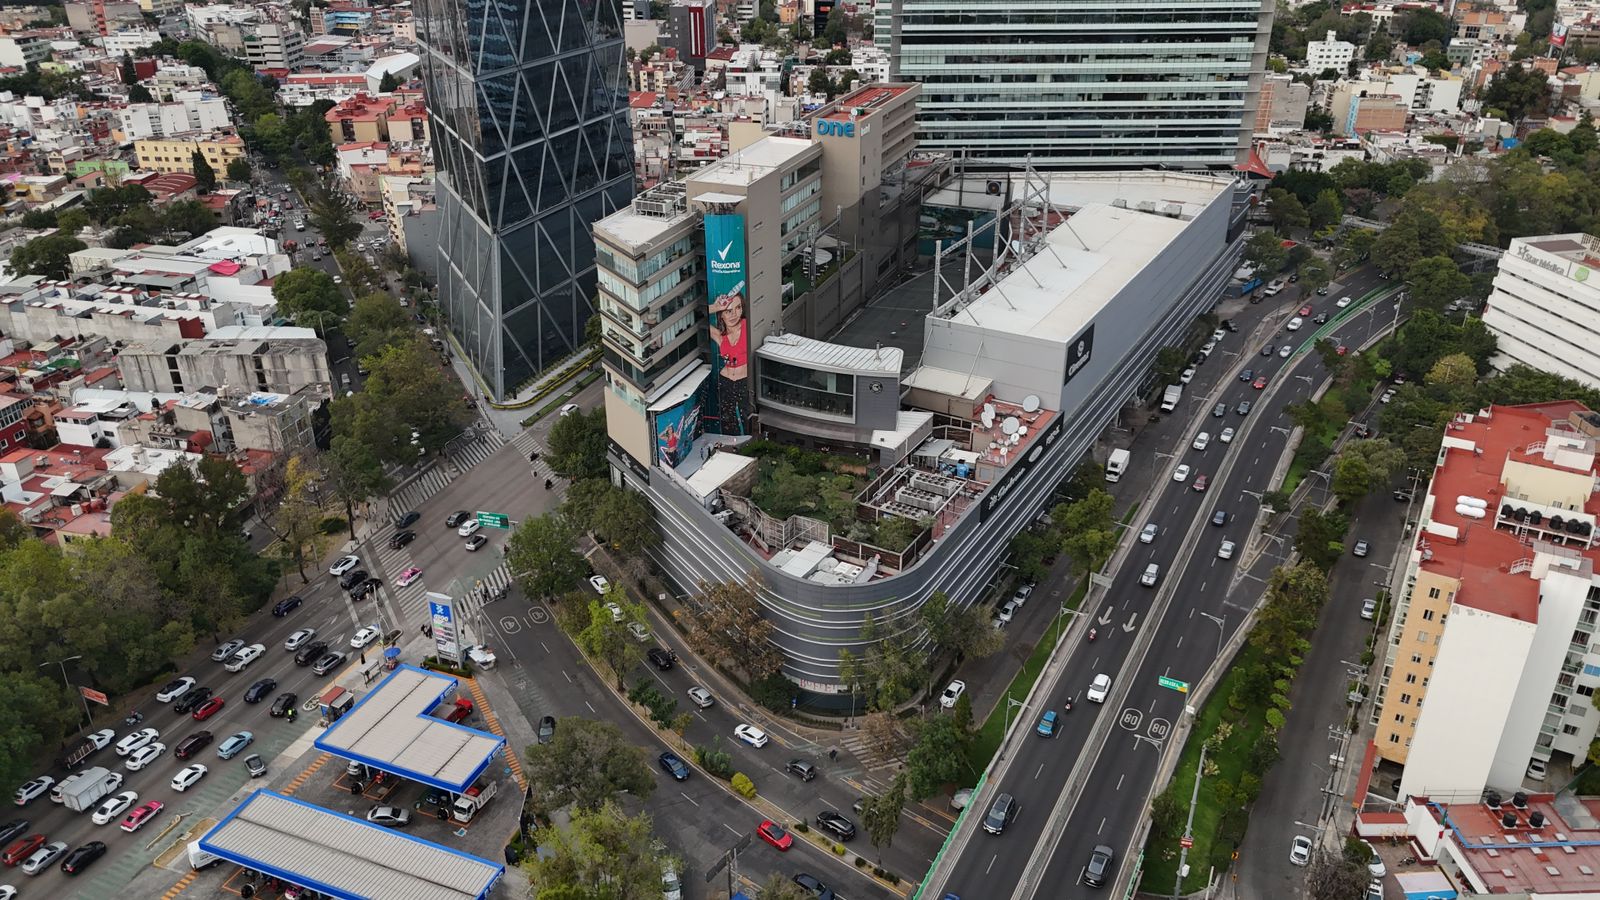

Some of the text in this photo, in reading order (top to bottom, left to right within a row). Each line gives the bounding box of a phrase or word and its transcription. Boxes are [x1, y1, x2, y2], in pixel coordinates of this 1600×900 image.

[711, 260, 741, 269] Rexona
[1525, 253, 1565, 276] Star Médica
[1124, 713, 1139, 726] 80
[1151, 723, 1167, 736] 80
